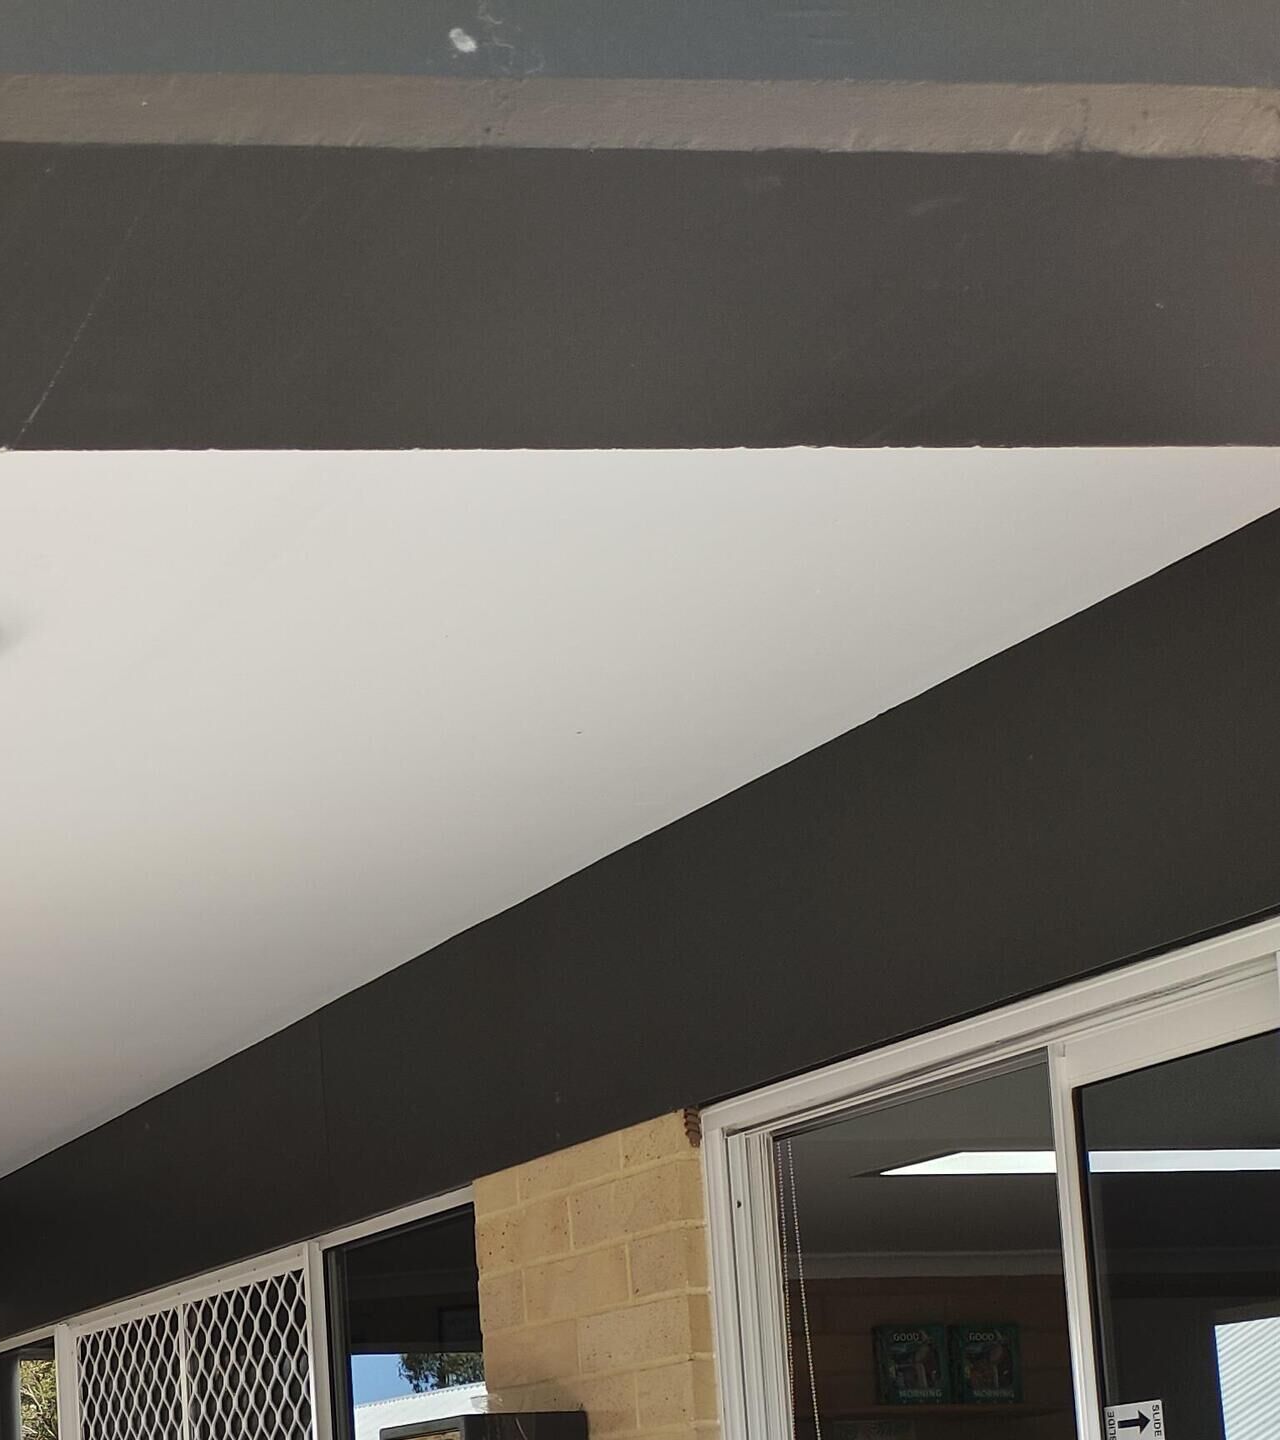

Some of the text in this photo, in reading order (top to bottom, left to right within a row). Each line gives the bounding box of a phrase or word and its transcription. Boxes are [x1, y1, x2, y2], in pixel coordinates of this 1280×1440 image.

[893, 1332, 920, 1343] GOOD
[968, 1332, 995, 1343] GOOD
[1151, 1404, 1162, 1438] SLIDE
